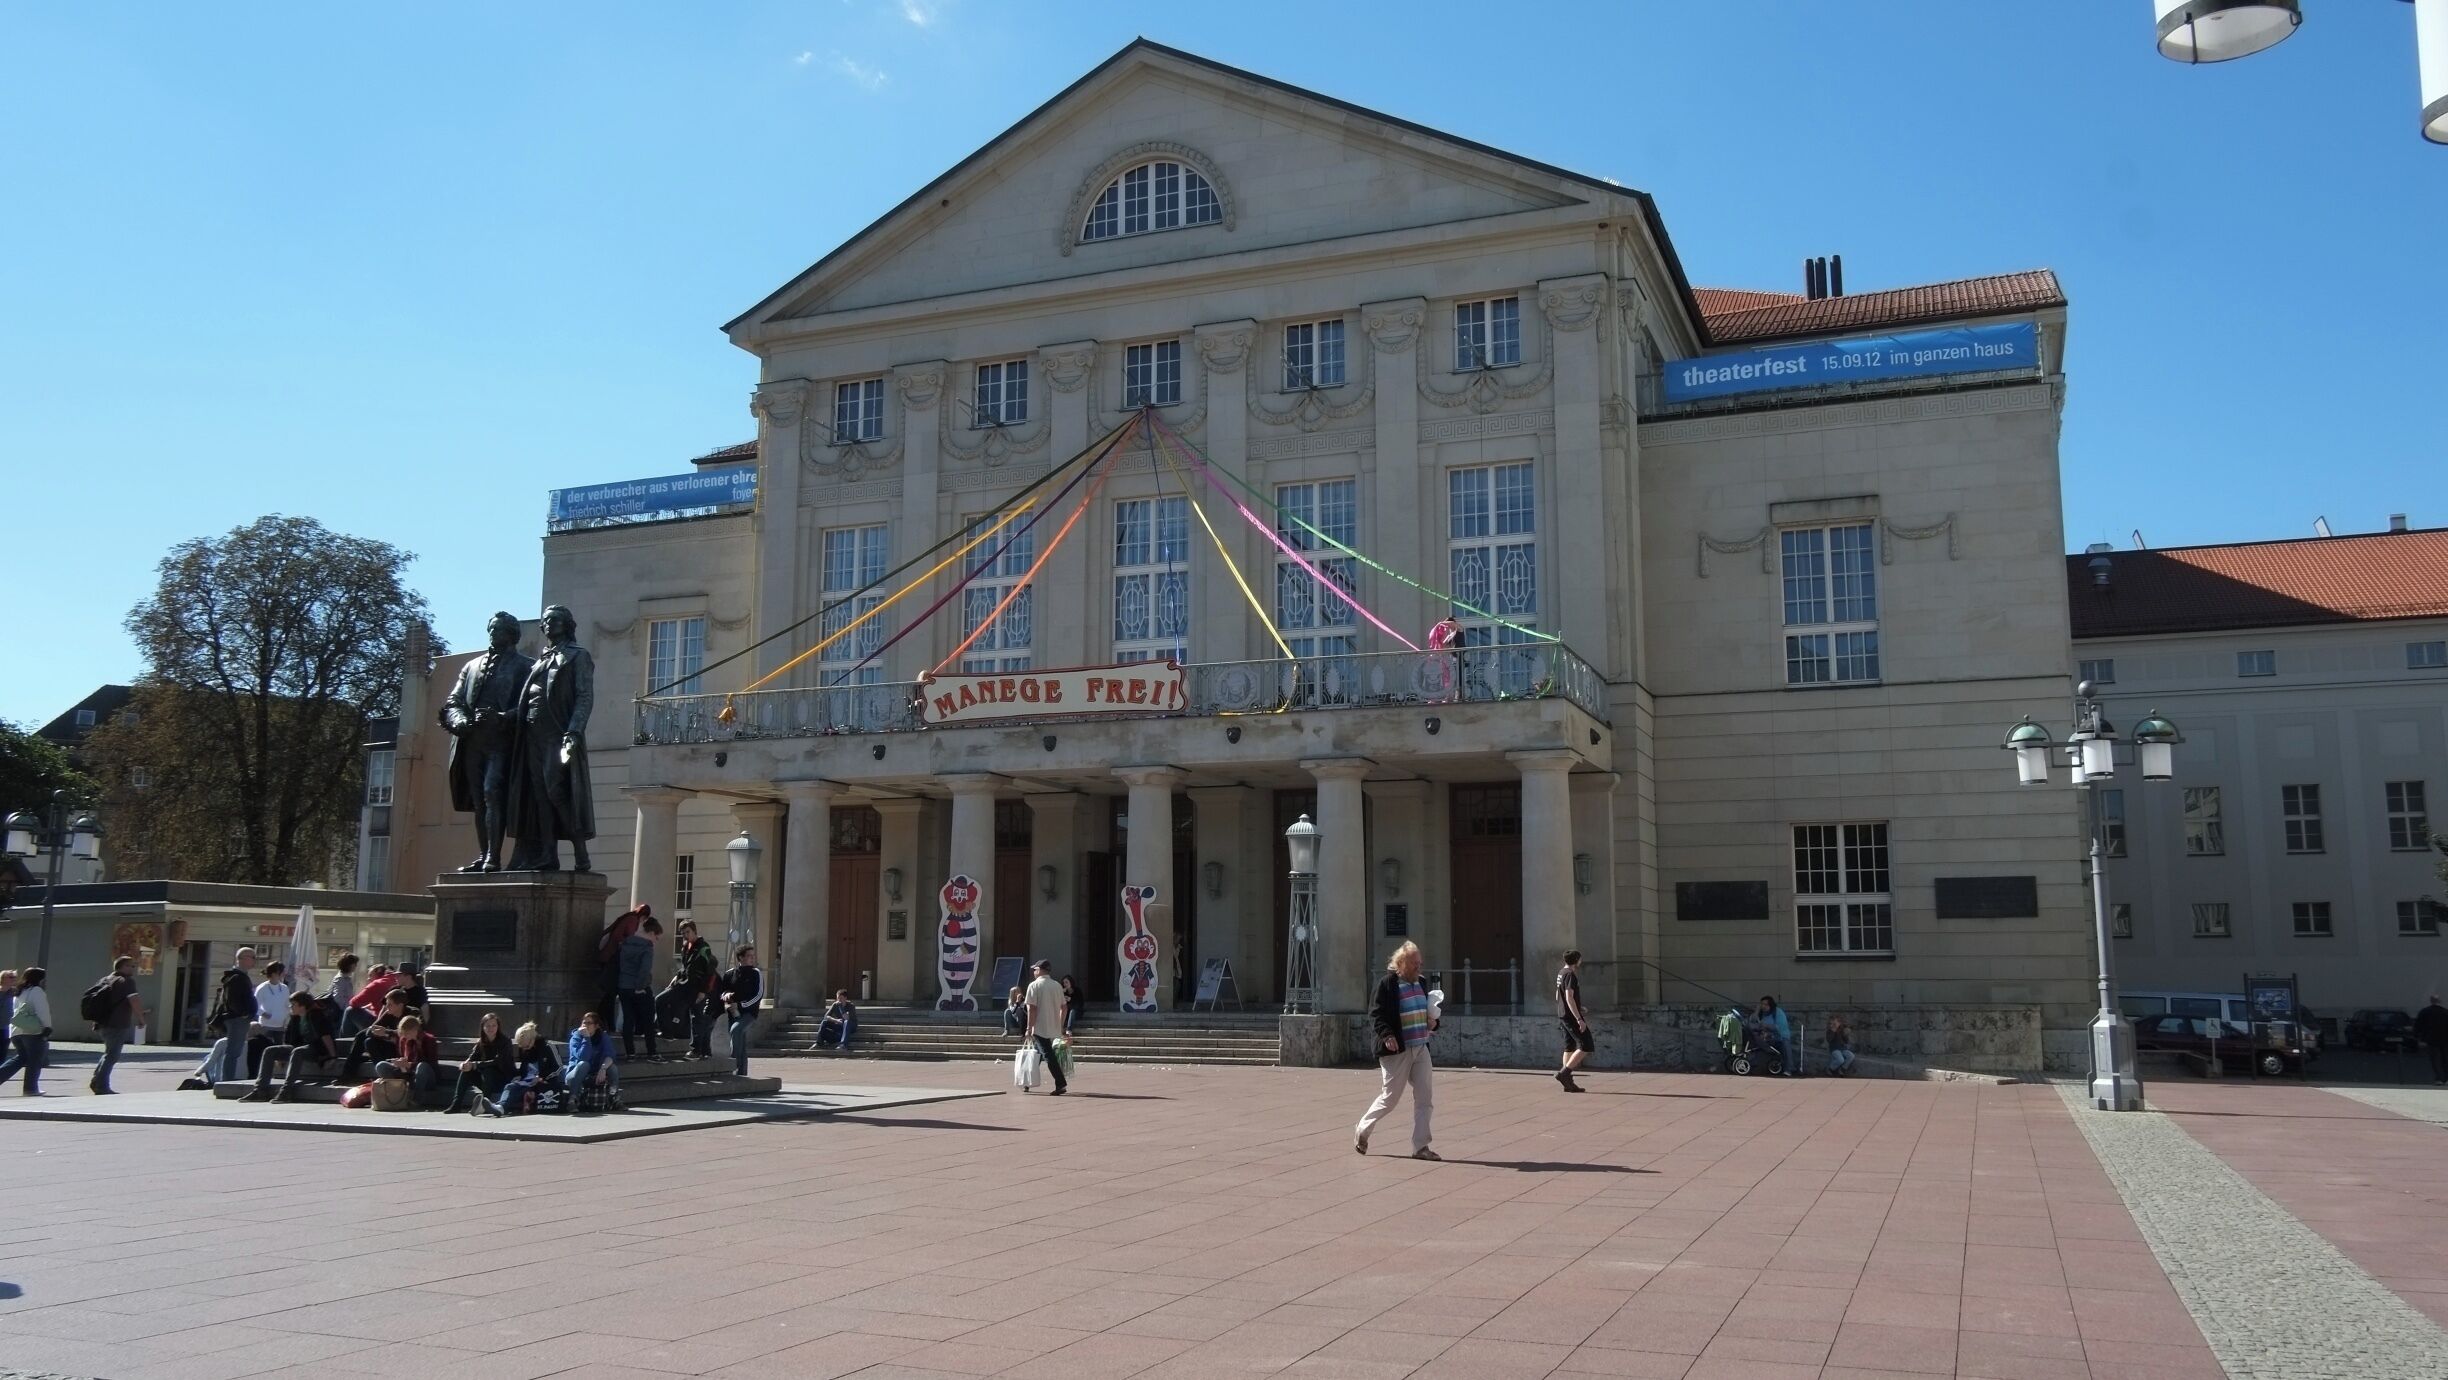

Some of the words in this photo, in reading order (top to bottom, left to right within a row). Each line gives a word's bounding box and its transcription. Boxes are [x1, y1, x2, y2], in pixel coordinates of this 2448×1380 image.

[1683, 355, 1807, 387] theaterfest
[1822, 351, 1881, 371] 15.09.12
[1890, 350, 1909, 366] im
[1914, 346, 1970, 367] ganzen
[1974, 342, 2014, 359] haus
[567, 491, 585, 503] der
[588, 484, 647, 501] verbrecher
[649, 480, 669, 493] aus
[671, 474, 729, 492] verlorener
[732, 470, 758, 485] ehre
[568, 502, 607, 519] friedrich
[610, 499, 646, 514] schiller
[933, 678, 1063, 720] MANEGE
[1086, 677, 1179, 710] FREI!
[259, 924, 284, 936] CITY
